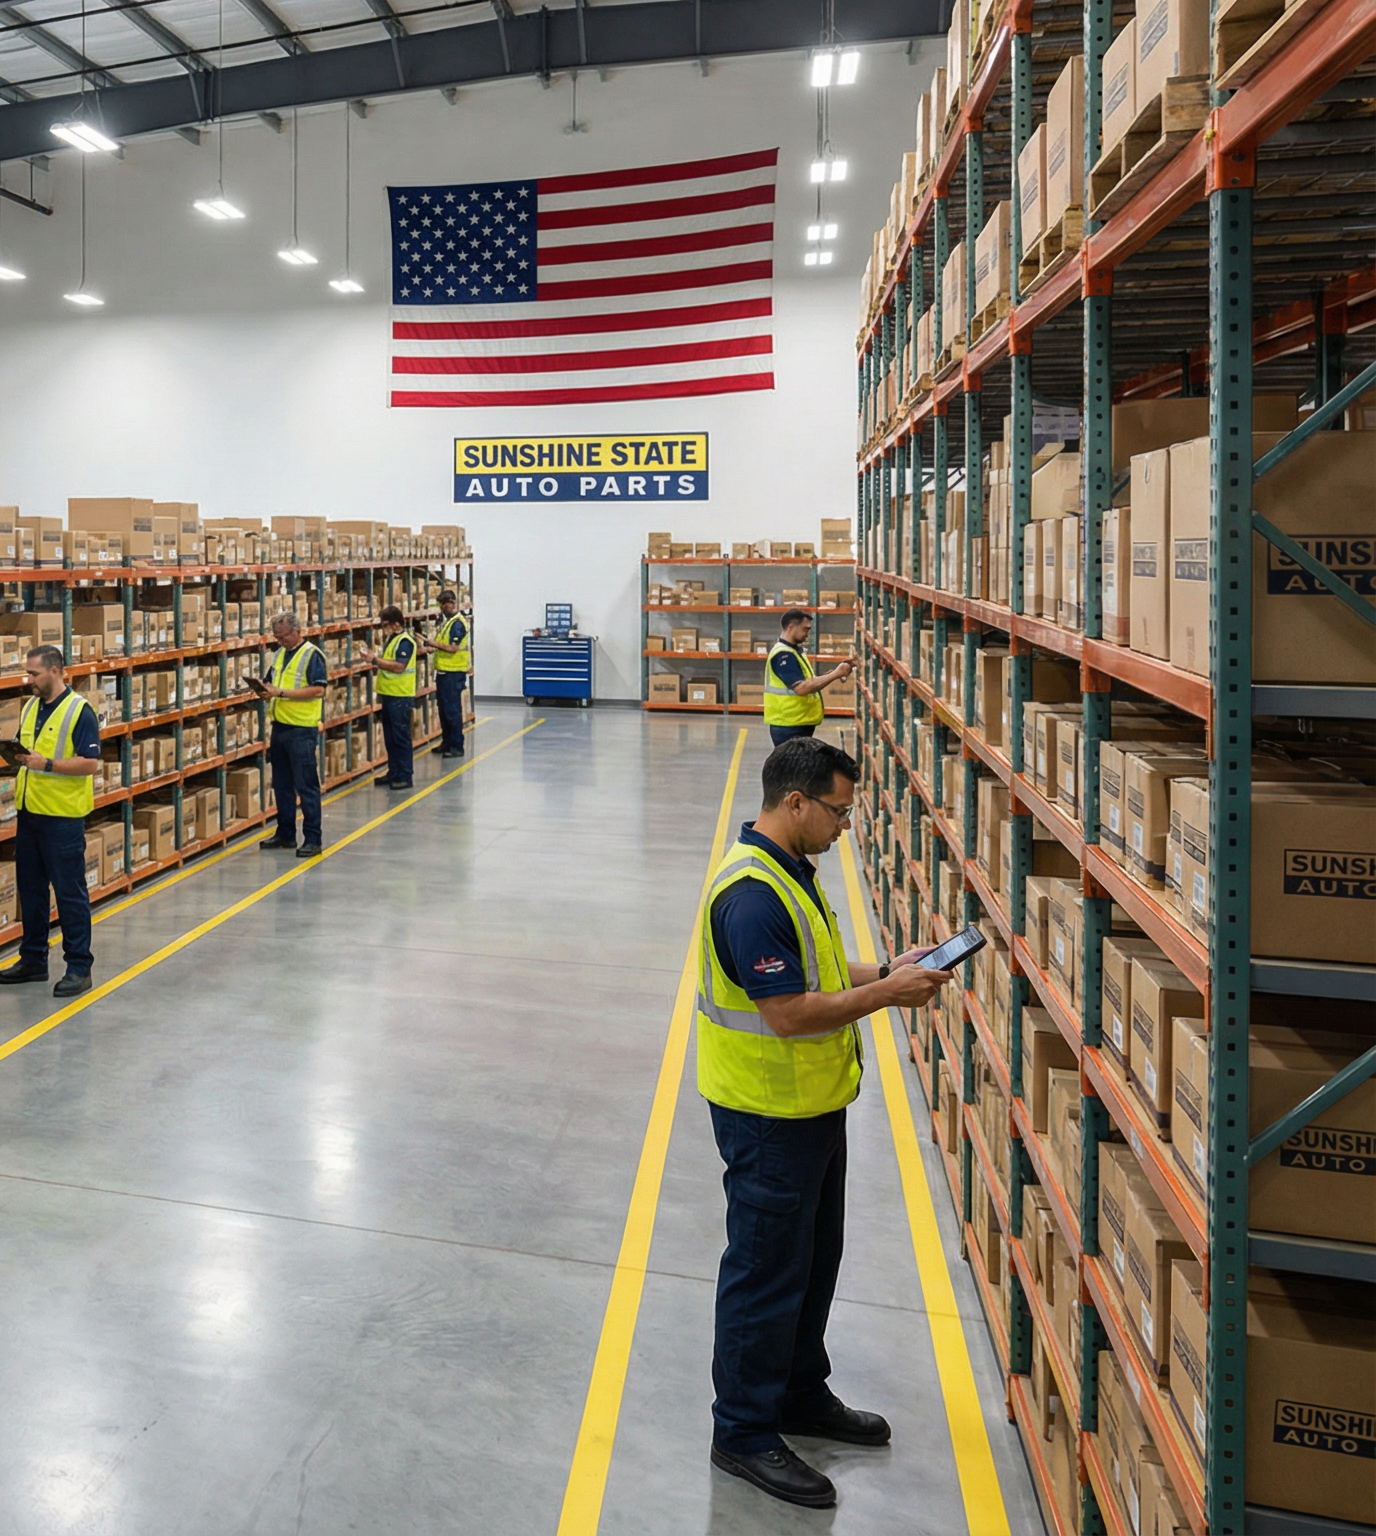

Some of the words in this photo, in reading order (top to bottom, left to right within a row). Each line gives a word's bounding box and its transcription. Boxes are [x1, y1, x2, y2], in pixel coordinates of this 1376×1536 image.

[464, 443, 602, 468] SUNSHINE
[610, 441, 696, 466] STATE
[465, 477, 559, 497] AUTO
[580, 475, 695, 496] PARTS
[1290, 1153, 1366, 1171] AUTO
[1283, 1429, 1358, 1453] AUTO
